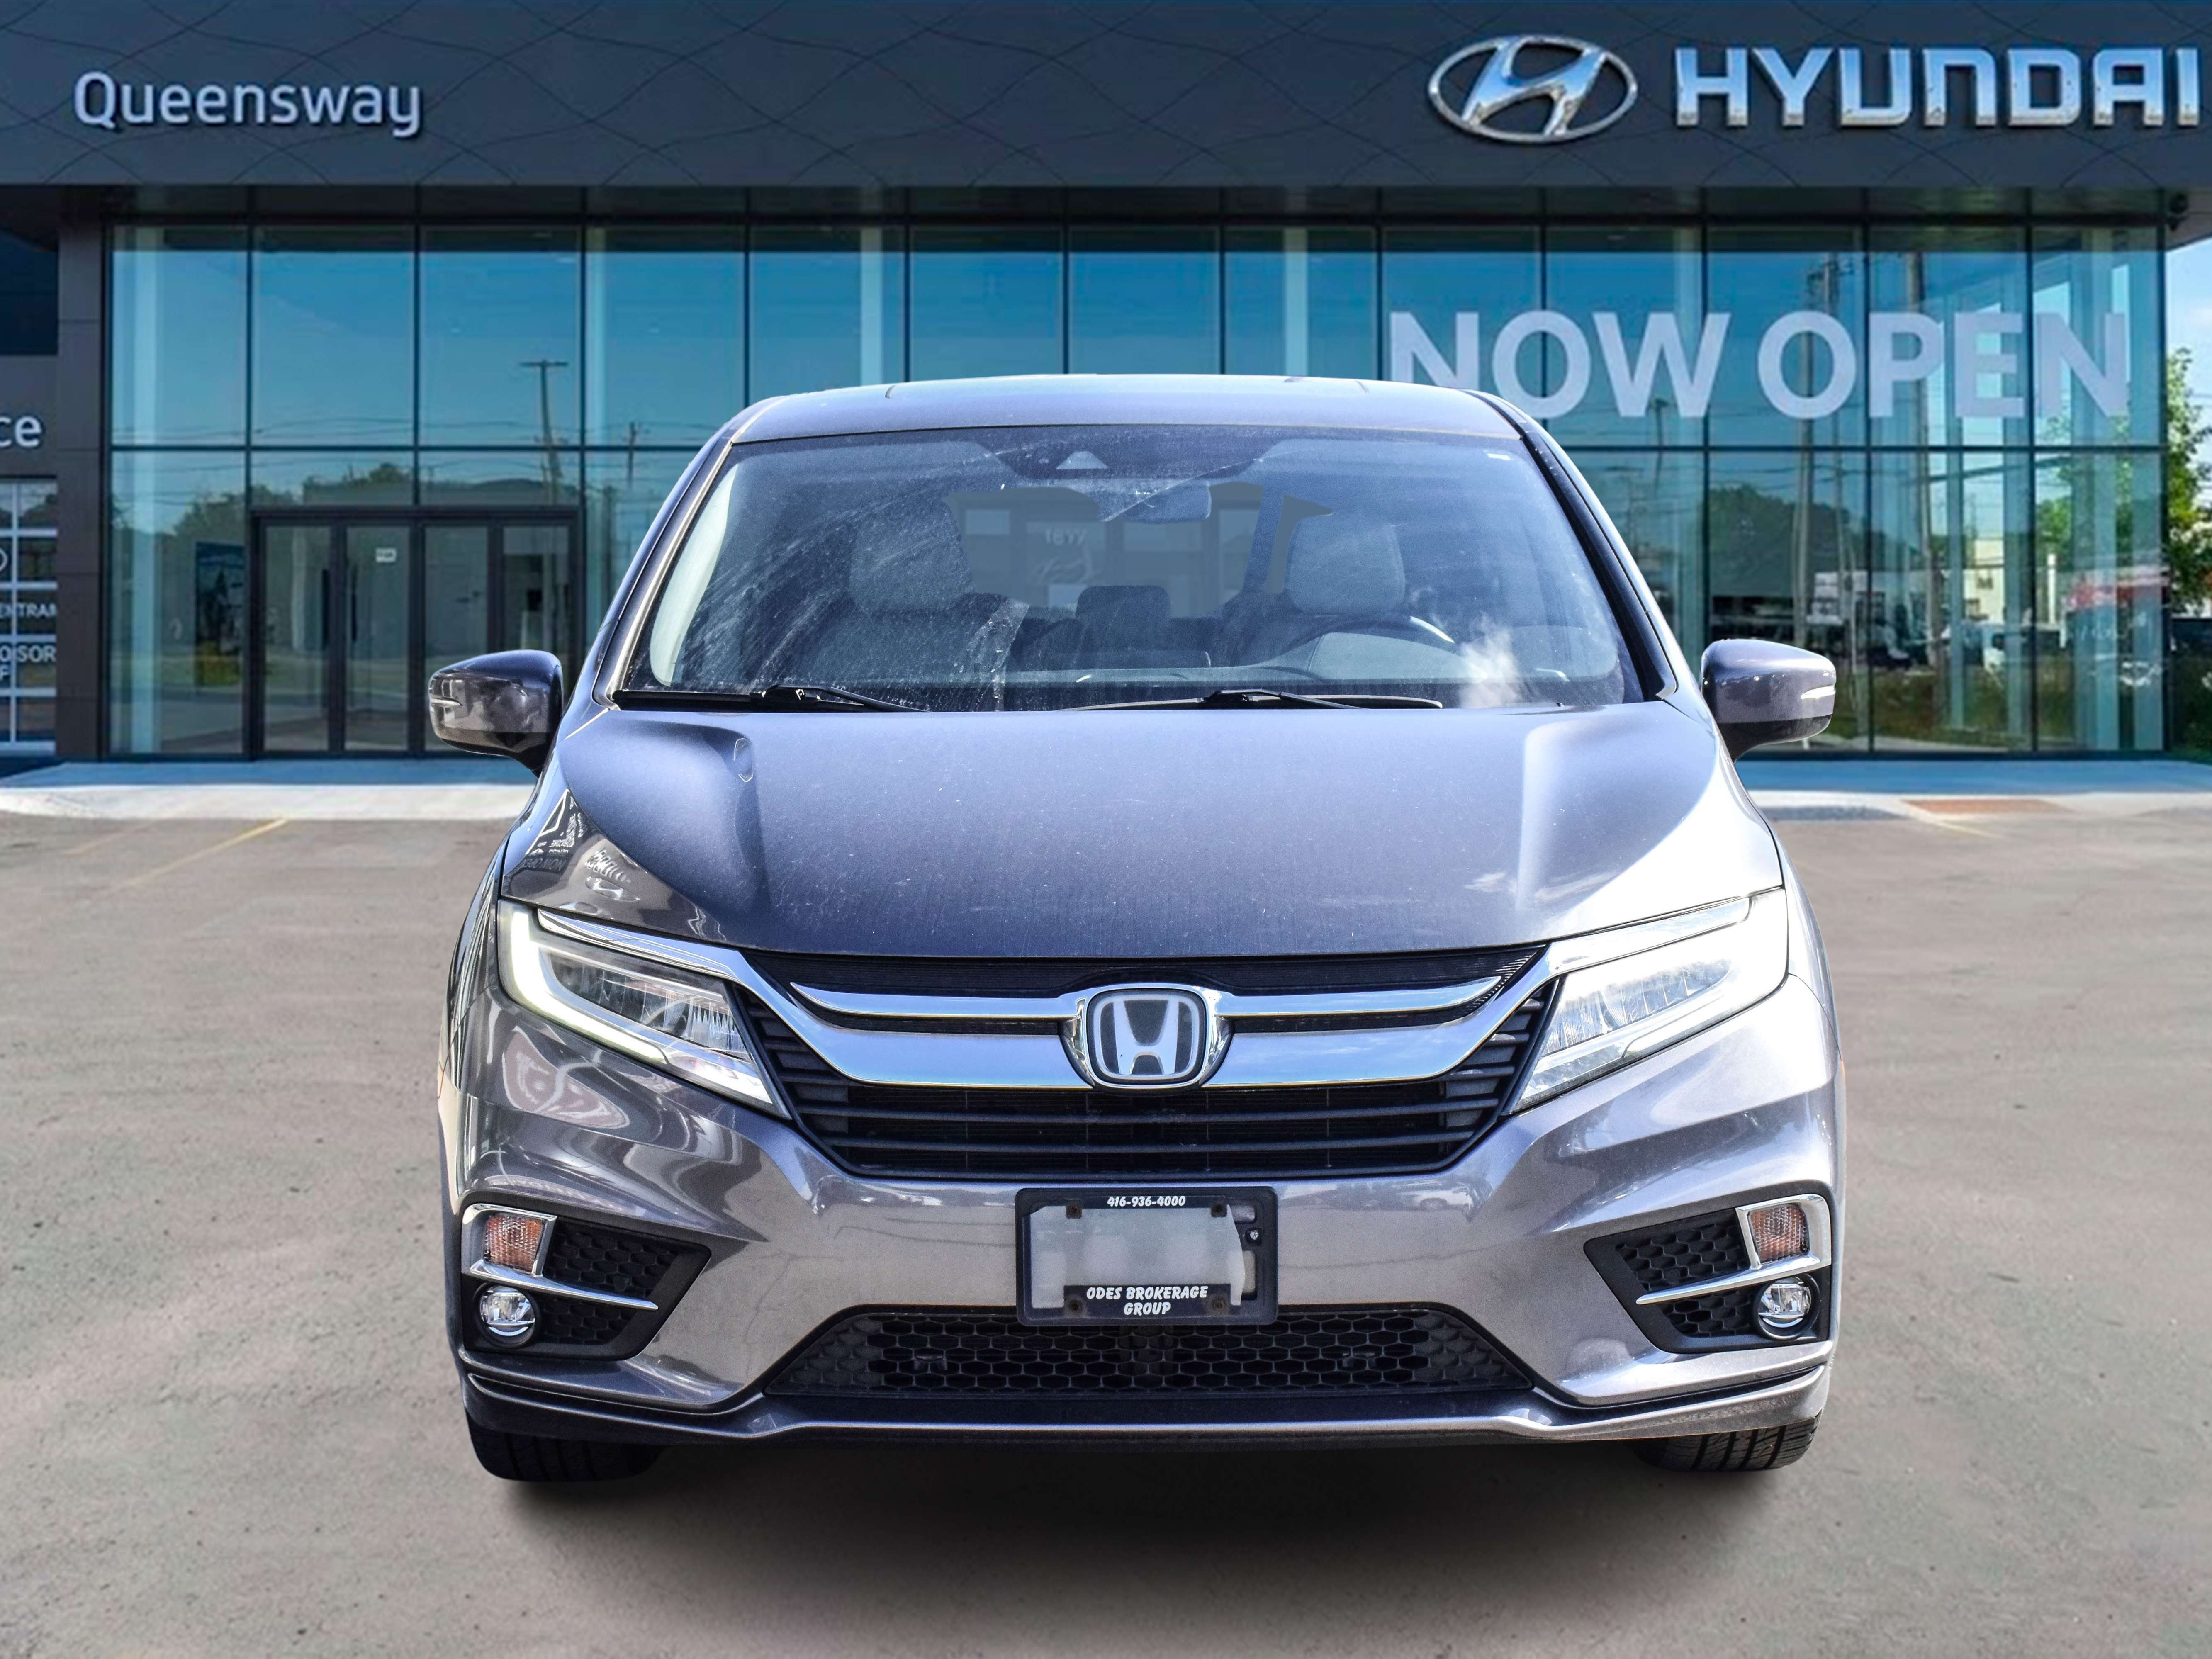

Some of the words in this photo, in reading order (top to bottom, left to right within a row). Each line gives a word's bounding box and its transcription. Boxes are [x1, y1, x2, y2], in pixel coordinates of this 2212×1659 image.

[74, 71, 420, 137] Queensway
[1676, 48, 2199, 125] HYUNDAI
[1390, 310, 1731, 419] NOW
[1757, 310, 2130, 418] OPEN
[1107, 1196, 1186, 1207] 416-936-4000
[1086, 1287, 1122, 1300] ODES
[1126, 1286, 1208, 1300] BROKERAGE
[1123, 1302, 1171, 1316] GROUP
